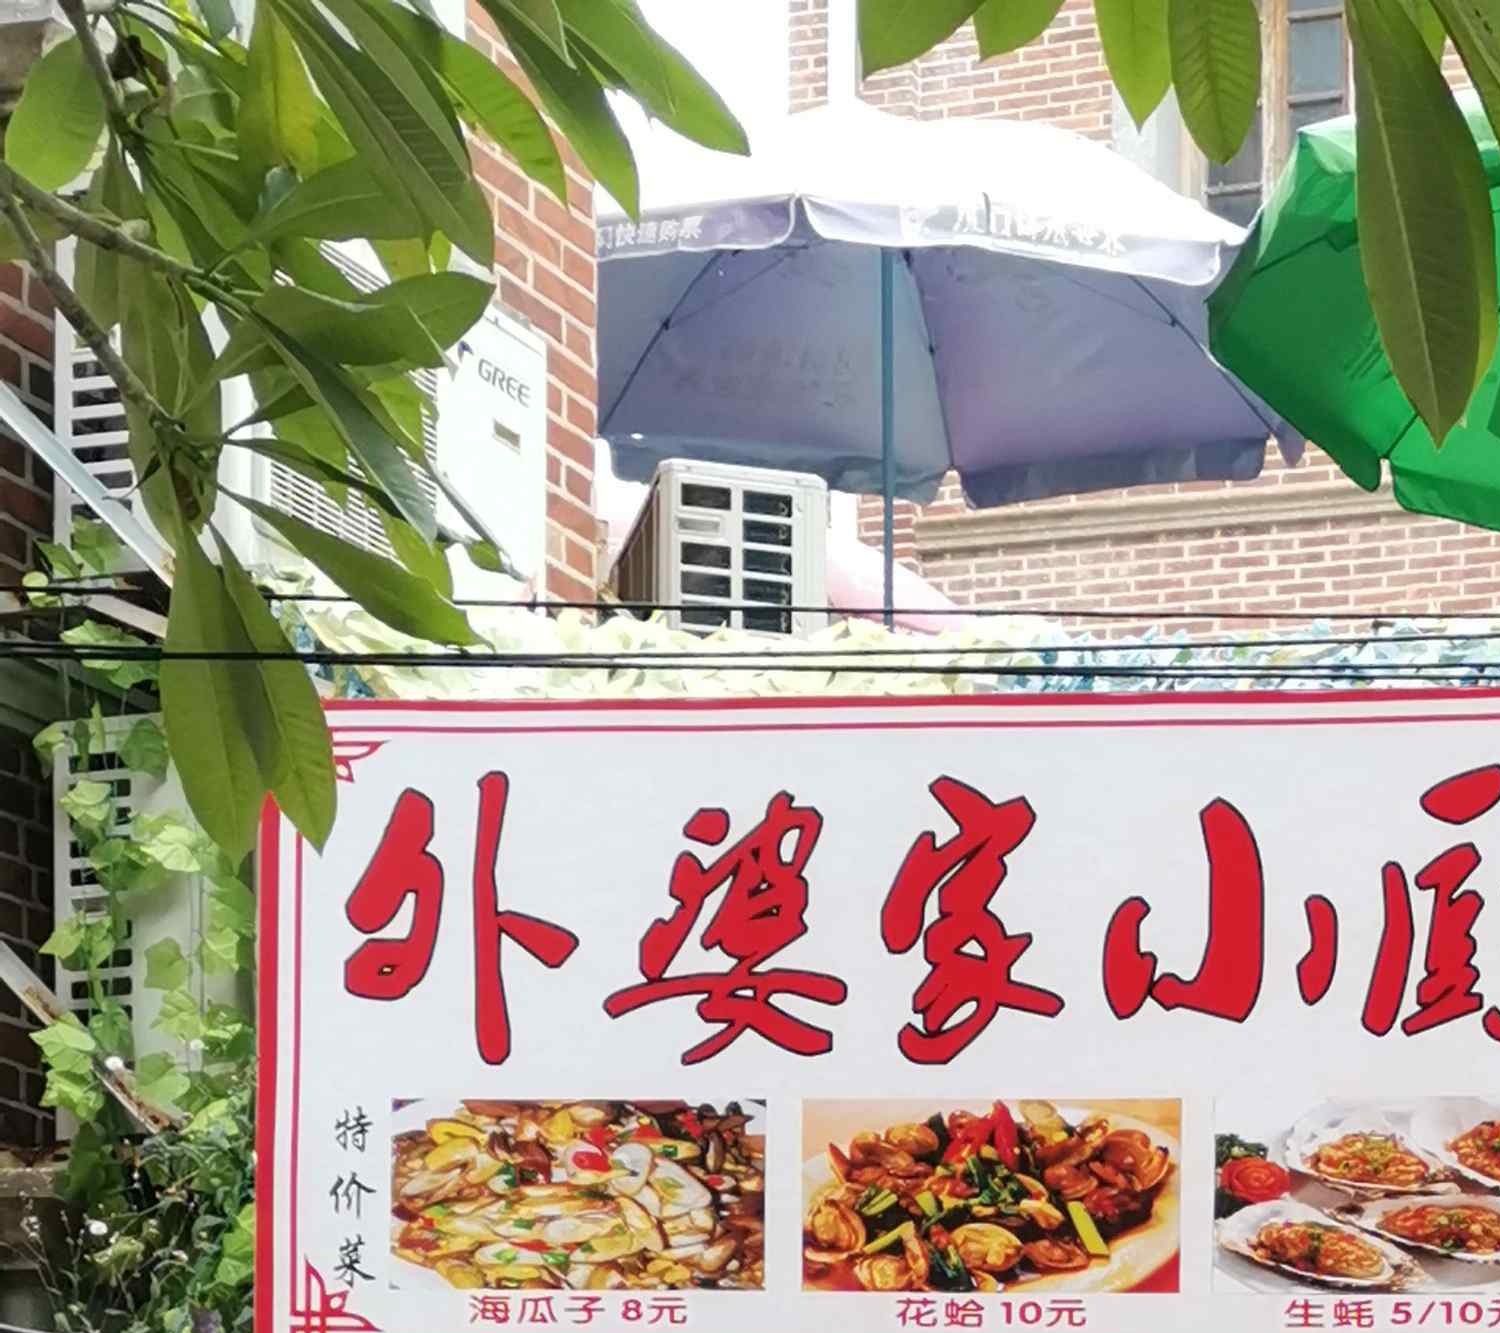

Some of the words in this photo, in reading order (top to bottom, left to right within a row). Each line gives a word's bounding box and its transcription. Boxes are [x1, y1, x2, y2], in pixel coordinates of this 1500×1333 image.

[478, 358, 532, 409] GREE
[329, 1106, 376, 1288] 特价菜
[468, 1295, 605, 1324] 海瓜子
[621, 1296, 688, 1324] 8元
[896, 1299, 985, 1328] 花蛤
[1001, 1300, 1087, 1328] 10元
[1284, 1299, 1374, 1329] 生蚝
